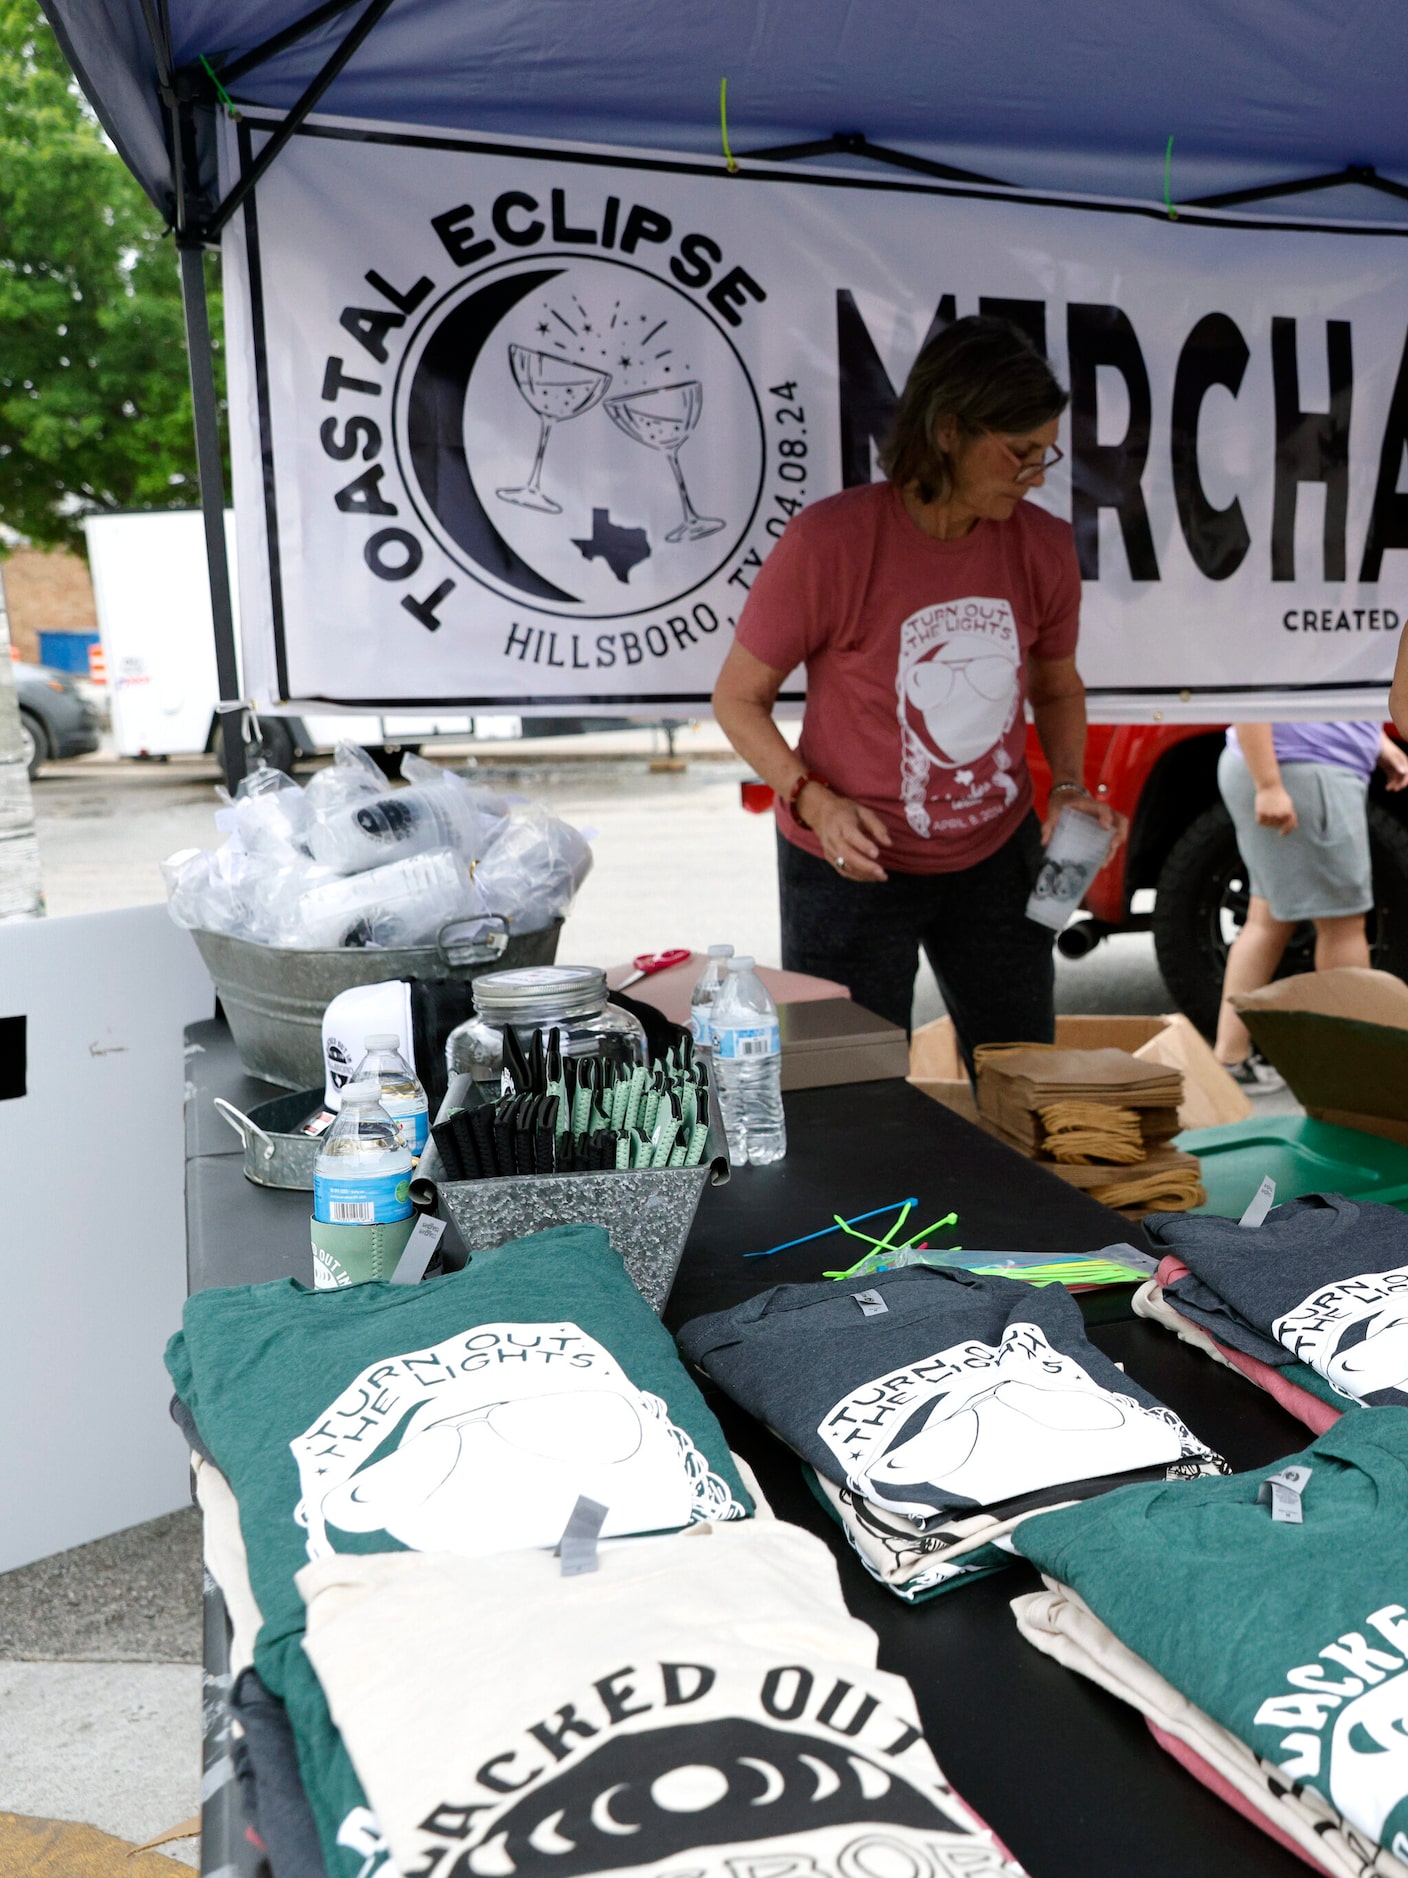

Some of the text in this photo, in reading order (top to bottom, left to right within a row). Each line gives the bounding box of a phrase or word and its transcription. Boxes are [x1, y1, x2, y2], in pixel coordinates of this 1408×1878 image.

[319, 187, 768, 633] TOASTAL ECLIPSE
[503, 601, 737, 669] HILLSBORO,
[906, 603, 1011, 632] TURN OUT
[906, 618, 1013, 649] THE LIGHTS
[1282, 608, 1400, 632] CREATED
[319, 1248, 342, 1271] OUT
[1277, 1280, 1370, 1346] TURN
[1294, 1307, 1351, 1354] THE
[307, 1332, 583, 1442] TURN OUT
[323, 1348, 597, 1459] THE LIGHTS
[827, 1358, 946, 1428] TURN
[841, 1391, 920, 1445] THE
[758, 1663, 927, 1758] OUT
